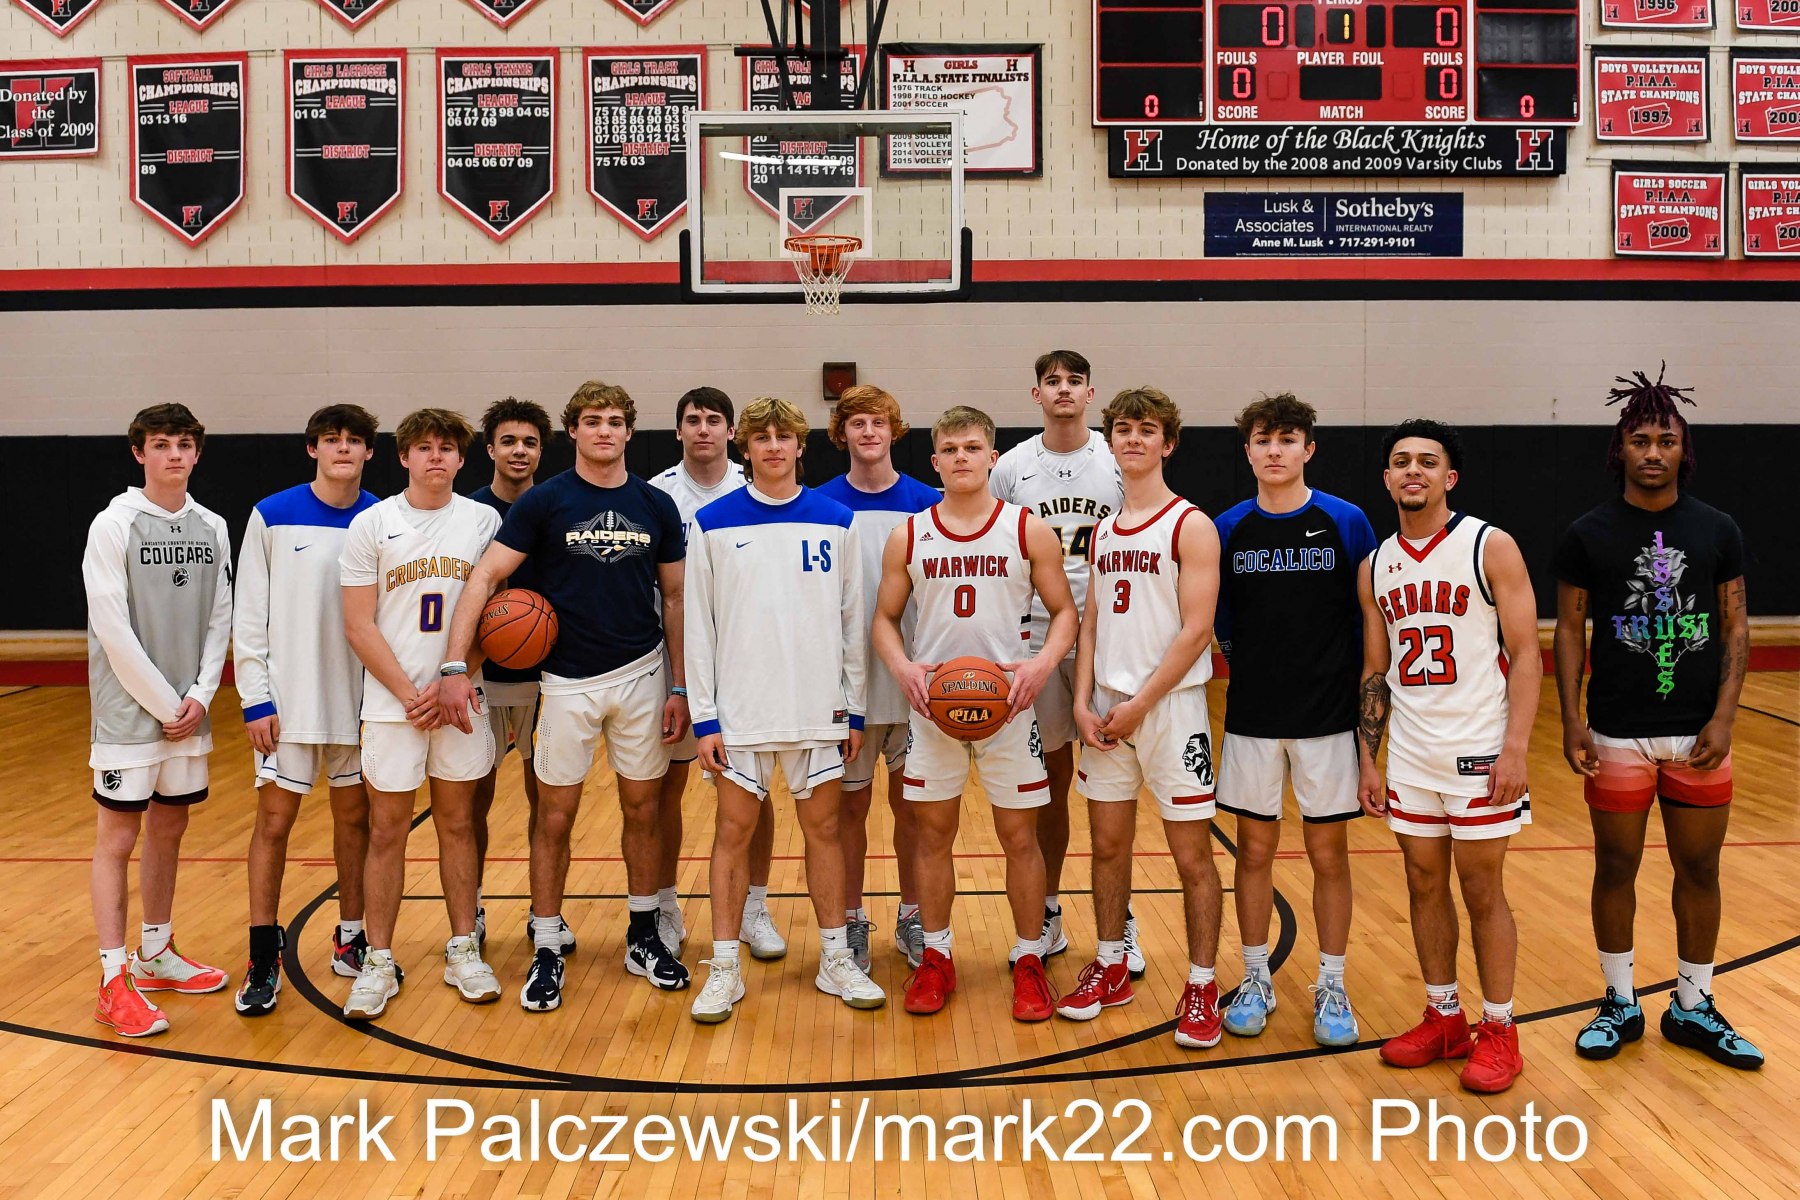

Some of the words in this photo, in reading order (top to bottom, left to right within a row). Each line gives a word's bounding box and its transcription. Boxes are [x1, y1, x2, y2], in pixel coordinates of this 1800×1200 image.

[1262, 7, 1284, 46] 0
[1344, 14, 1350, 39] 1
[1436, 8, 1458, 46] 0
[1217, 52, 1257, 64] FOULS
[1298, 52, 1344, 65] PLAYER
[1353, 52, 1384, 65] FOUL
[1424, 52, 1463, 65] FOULS
[304, 65, 333, 78] GIRLS
[336, 64, 387, 77] LACROSSE
[462, 63, 491, 75] GIRLS
[495, 63, 533, 75] TENNIS
[611, 62, 640, 75] GIRLS
[644, 61, 678, 74] TRACK
[944, 60, 978, 70] GIRLS
[1601, 63, 1628, 73] BOYS
[1632, 63, 1699, 73] VOLLEYBALL
[1740, 65, 1765, 74] BOYS
[163, 69, 212, 82] SOFTBALL
[893, 74, 933, 83] P.I.A.A.
[935, 74, 969, 83] STATE
[972, 73, 1029, 82] FINALISTS
[1626, 75, 1676, 87] P.I.A.A.
[295, 79, 396, 96] CHAMPIONSHIPS
[447, 77, 548, 94] CHAMPIONSHIPS
[594, 76, 696, 93] CHAMPIONSHIPS
[1233, 68, 1251, 98] 0
[1440, 68, 1457, 99] 0
[0, 88, 64, 102] Donated
[69, 88, 87, 104] by
[139, 82, 238, 102] CHAMPIONSHIPS
[1601, 90, 1636, 104] STATE
[1640, 90, 1699, 105] CHAMPIONS
[1739, 91, 1773, 105] STATE
[326, 95, 366, 109] LEAGUE
[478, 94, 518, 107] LEAGUE
[625, 93, 666, 106] LEAGUE
[1144, 95, 1159, 117] 0
[1520, 95, 1535, 117] 0
[32, 107, 55, 119] the
[169, 100, 209, 114] LEAGUE
[447, 108, 462, 117] 67
[464, 108, 478, 117] 71
[482, 108, 496, 117] 73
[499, 108, 513, 117] 98
[517, 108, 531, 117] 04
[534, 108, 549, 117] 05
[595, 106, 609, 116] 75
[612, 106, 626, 116] 76
[630, 106, 643, 116] 77
[647, 106, 661, 116] 78
[665, 106, 679, 116] 79
[1218, 106, 1257, 118] SCORE
[1320, 106, 1363, 118] MATCH
[1425, 106, 1465, 119] SCORE
[140, 115, 154, 125] 03
[156, 115, 170, 124] 13
[173, 114, 187, 124] 16
[295, 110, 308, 119] 01
[311, 109, 326, 118] 02
[1633, 110, 1669, 123] 1997
[448, 117, 462, 126] 06
[464, 117, 478, 126] 07
[482, 117, 497, 126] 09
[38, 124, 54, 137] of
[60, 123, 94, 137] 2009
[780, 141, 827, 154] DISTRICT
[1197, 128, 1259, 150] Home
[1266, 127, 1293, 156] of
[1295, 127, 1328, 149] the
[1333, 127, 1400, 153] Black
[1401, 128, 1486, 154] Knights
[323, 145, 370, 158] DISTRICT
[474, 144, 522, 156] DISTRICT
[623, 142, 670, 155] DISTRICT
[167, 149, 213, 163] DISTRICT
[448, 158, 462, 167] 04
[465, 158, 479, 167] 05
[482, 158, 496, 167] 06
[500, 158, 514, 167] 07
[518, 158, 533, 167] 09
[596, 157, 610, 167] 75
[613, 157, 627, 167] 76
[630, 157, 645, 167] 03
[141, 165, 156, 175] 89
[1176, 157, 1243, 170] Donated
[1248, 157, 1259, 173] by
[1264, 157, 1287, 170] the
[1291, 158, 1328, 169] 2008
[1333, 157, 1360, 169] and
[1365, 158, 1401, 170] 2009
[1407, 157, 1458, 173] Varsity
[1463, 157, 1502, 169] Clubs
[753, 175, 768, 183] 20
[1633, 179, 1664, 189] GIRLS
[1669, 179, 1707, 189] SOCCER
[1748, 181, 1777, 189] GIRLS
[1646, 190, 1695, 202] P.I.A.A.
[1264, 199, 1298, 213] Lusk
[1302, 199, 1314, 213] &
[1336, 198, 1433, 221] Sotheby's
[1621, 205, 1655, 219] STATE
[1659, 206, 1718, 221] CHAMPIONS
[1749, 207, 1782, 220] STATE
[1235, 219, 1314, 233] Associates
[1651, 225, 1689, 238] 2000
[1252, 238, 1280, 247] Anne
[1284, 238, 1297, 247] M.
[1300, 237, 1323, 247] Lusk
[1339, 238, 1415, 247] 717-291-9101
[1029, 497, 1111, 519] AIDERS
[566, 530, 651, 543] RAIDERS
[140, 547, 214, 565] COUGARS
[802, 540, 831, 572] L-S
[1233, 548, 1335, 573] COCALICO
[922, 555, 1008, 579] WARWICK
[386, 556, 474, 592] CRUSADER
[954, 584, 976, 618] 0
[1113, 580, 1131, 614] 3
[1379, 580, 1470, 625] CEDARS
[420, 592, 445, 633] 0
[1398, 625, 1457, 686] 23
[942, 680, 999, 695] SPALDING
